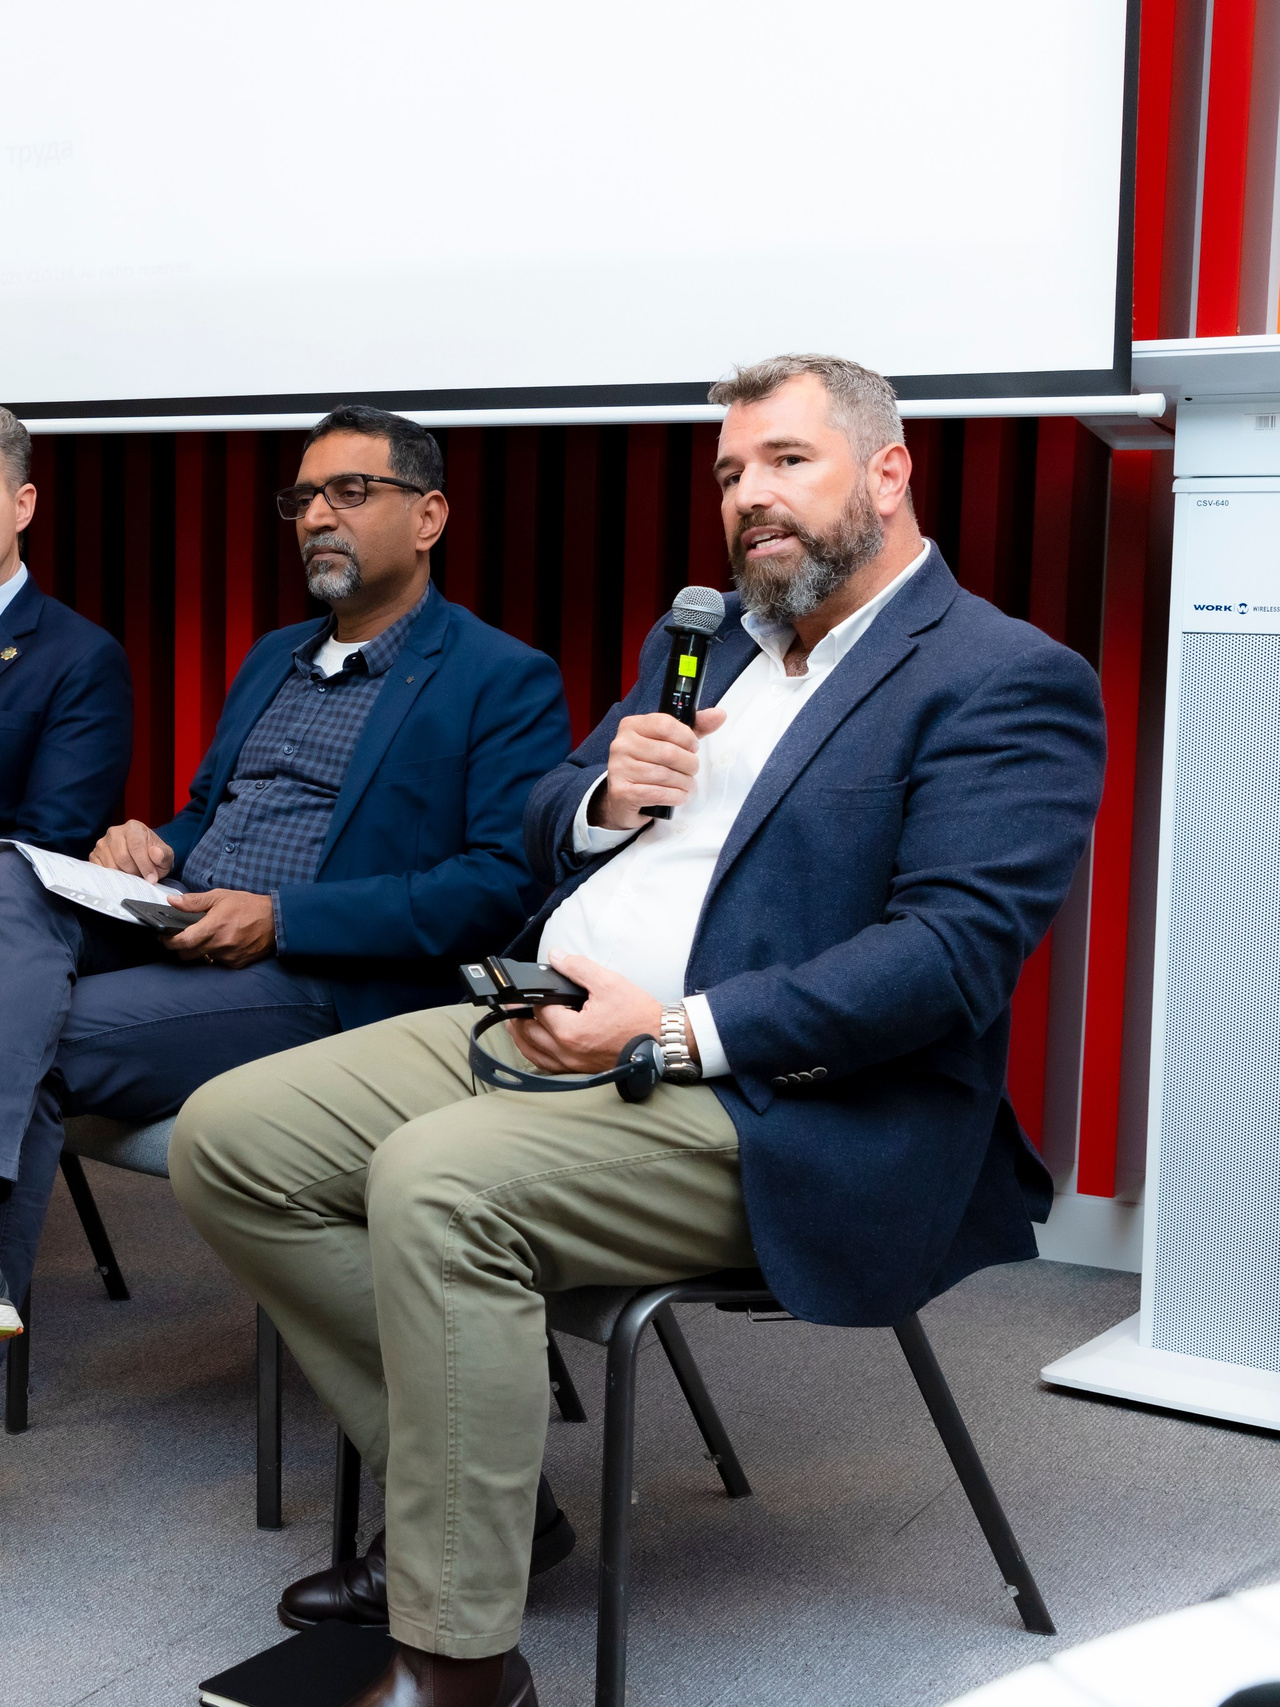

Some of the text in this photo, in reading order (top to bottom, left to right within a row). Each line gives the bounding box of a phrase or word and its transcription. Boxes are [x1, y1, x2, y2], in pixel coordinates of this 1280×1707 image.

[5, 139, 75, 170] труда
[1197, 499, 1229, 507] CSV-640
[1193, 604, 1232, 612] WORK
